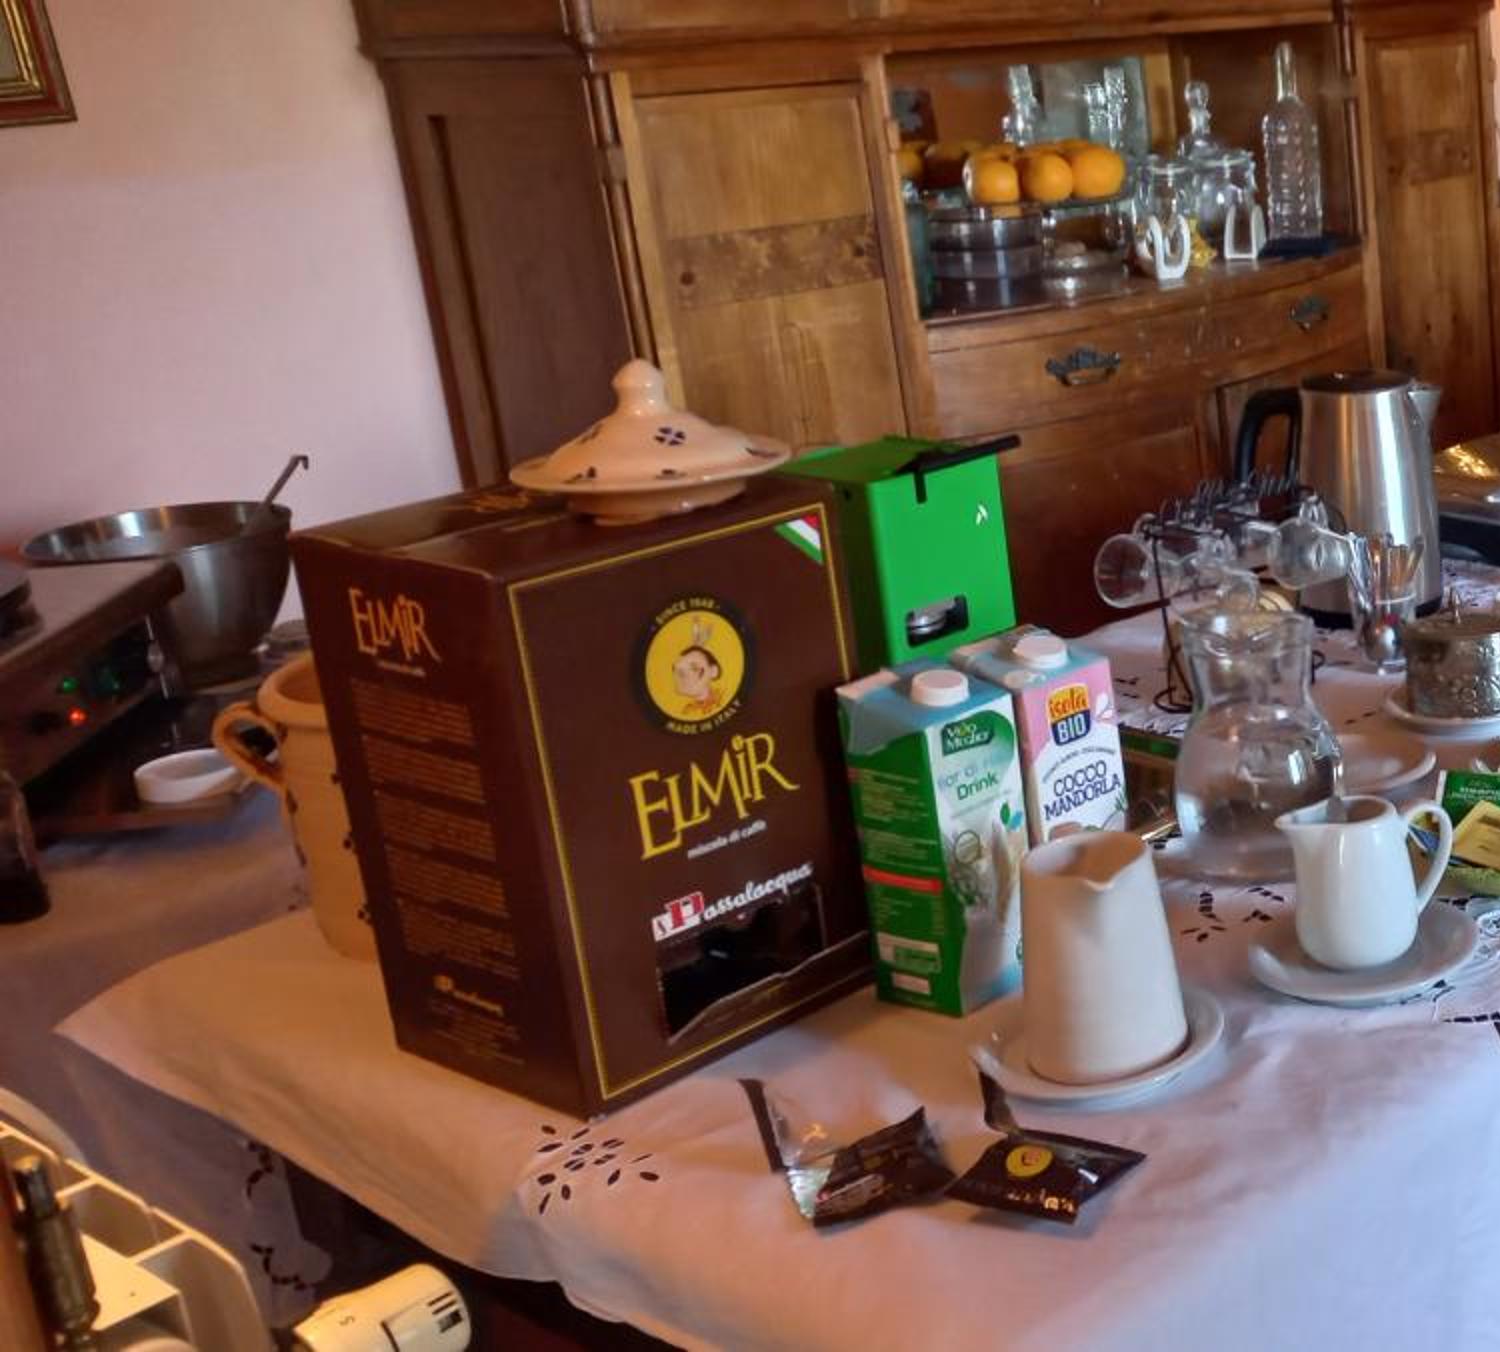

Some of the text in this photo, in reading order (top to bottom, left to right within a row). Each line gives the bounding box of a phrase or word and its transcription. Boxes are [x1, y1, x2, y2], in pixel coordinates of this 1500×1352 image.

[655, 600, 686, 625] SINCE
[666, 721, 698, 735] MADE
[1057, 713, 1087, 744] BIO
[956, 770, 999, 801] Drink
[1053, 760, 1107, 797] COCCO
[1043, 773, 1121, 821] MANDORLA
